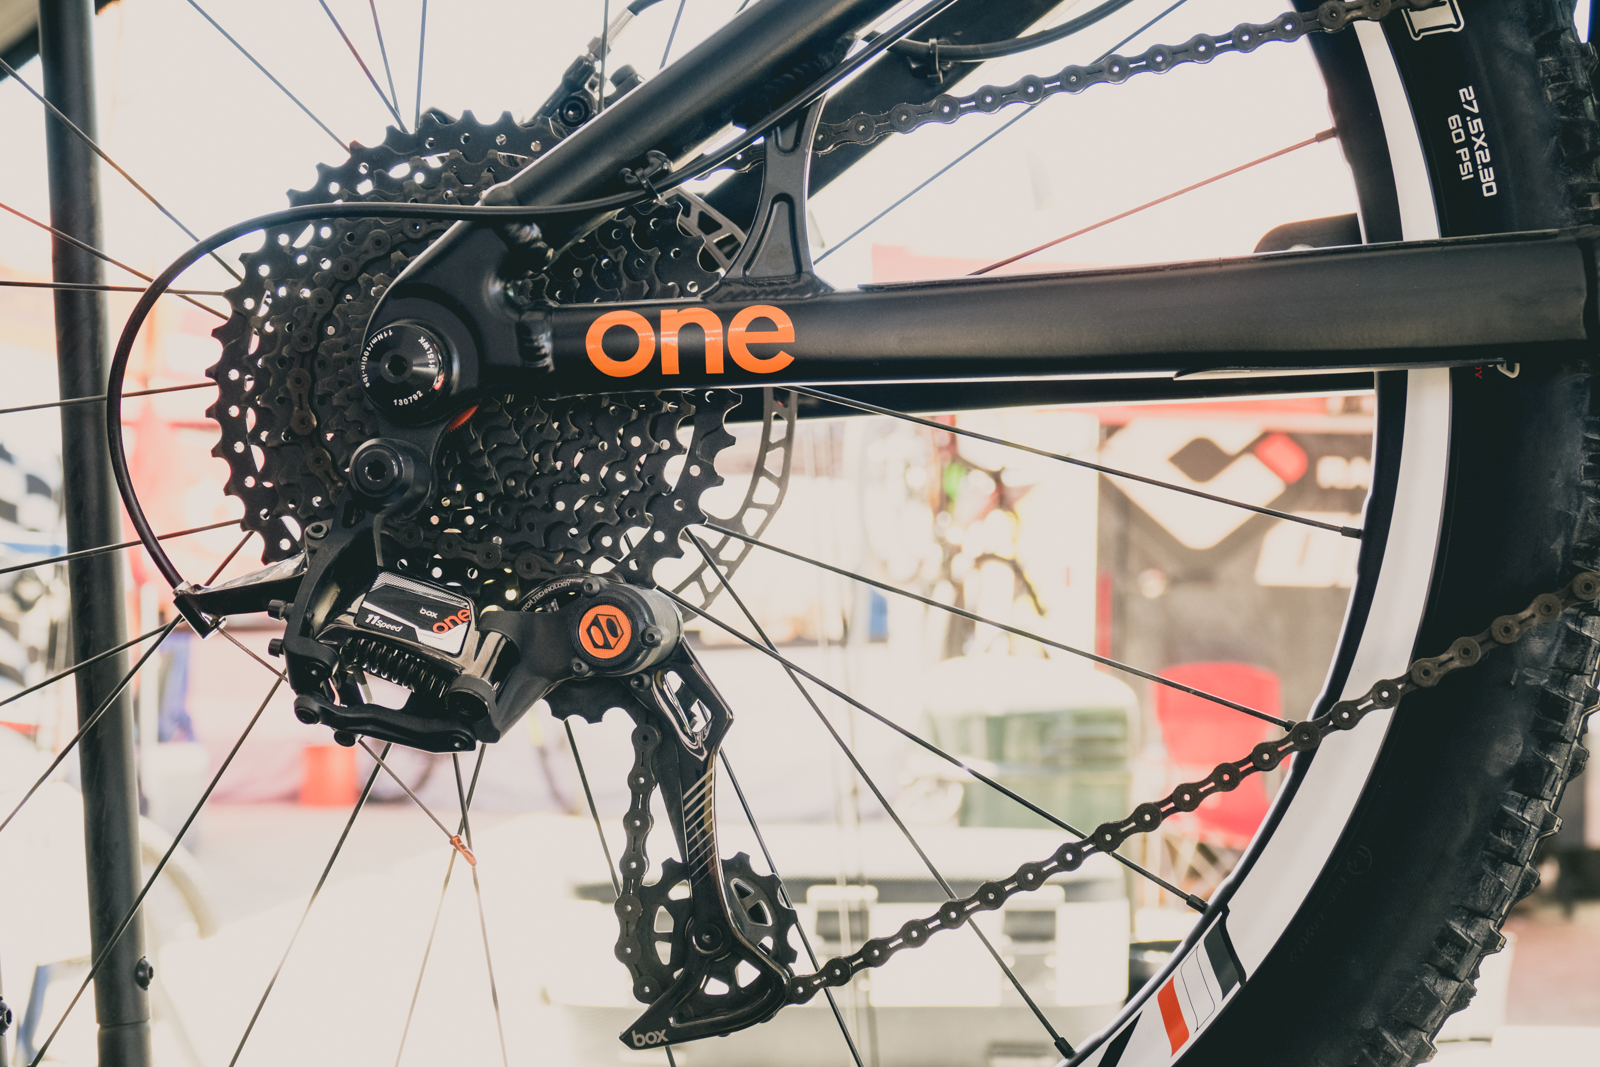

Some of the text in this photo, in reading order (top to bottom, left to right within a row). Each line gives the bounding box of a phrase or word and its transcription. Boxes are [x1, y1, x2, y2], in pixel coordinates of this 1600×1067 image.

[1447, 113, 1475, 181] 60 PSI
[585, 304, 796, 378] one
[393, 390, 423, 406] 130792
[419, 607, 439, 619] box
[432, 609, 470, 634] one
[631, 1029, 669, 1047] box
